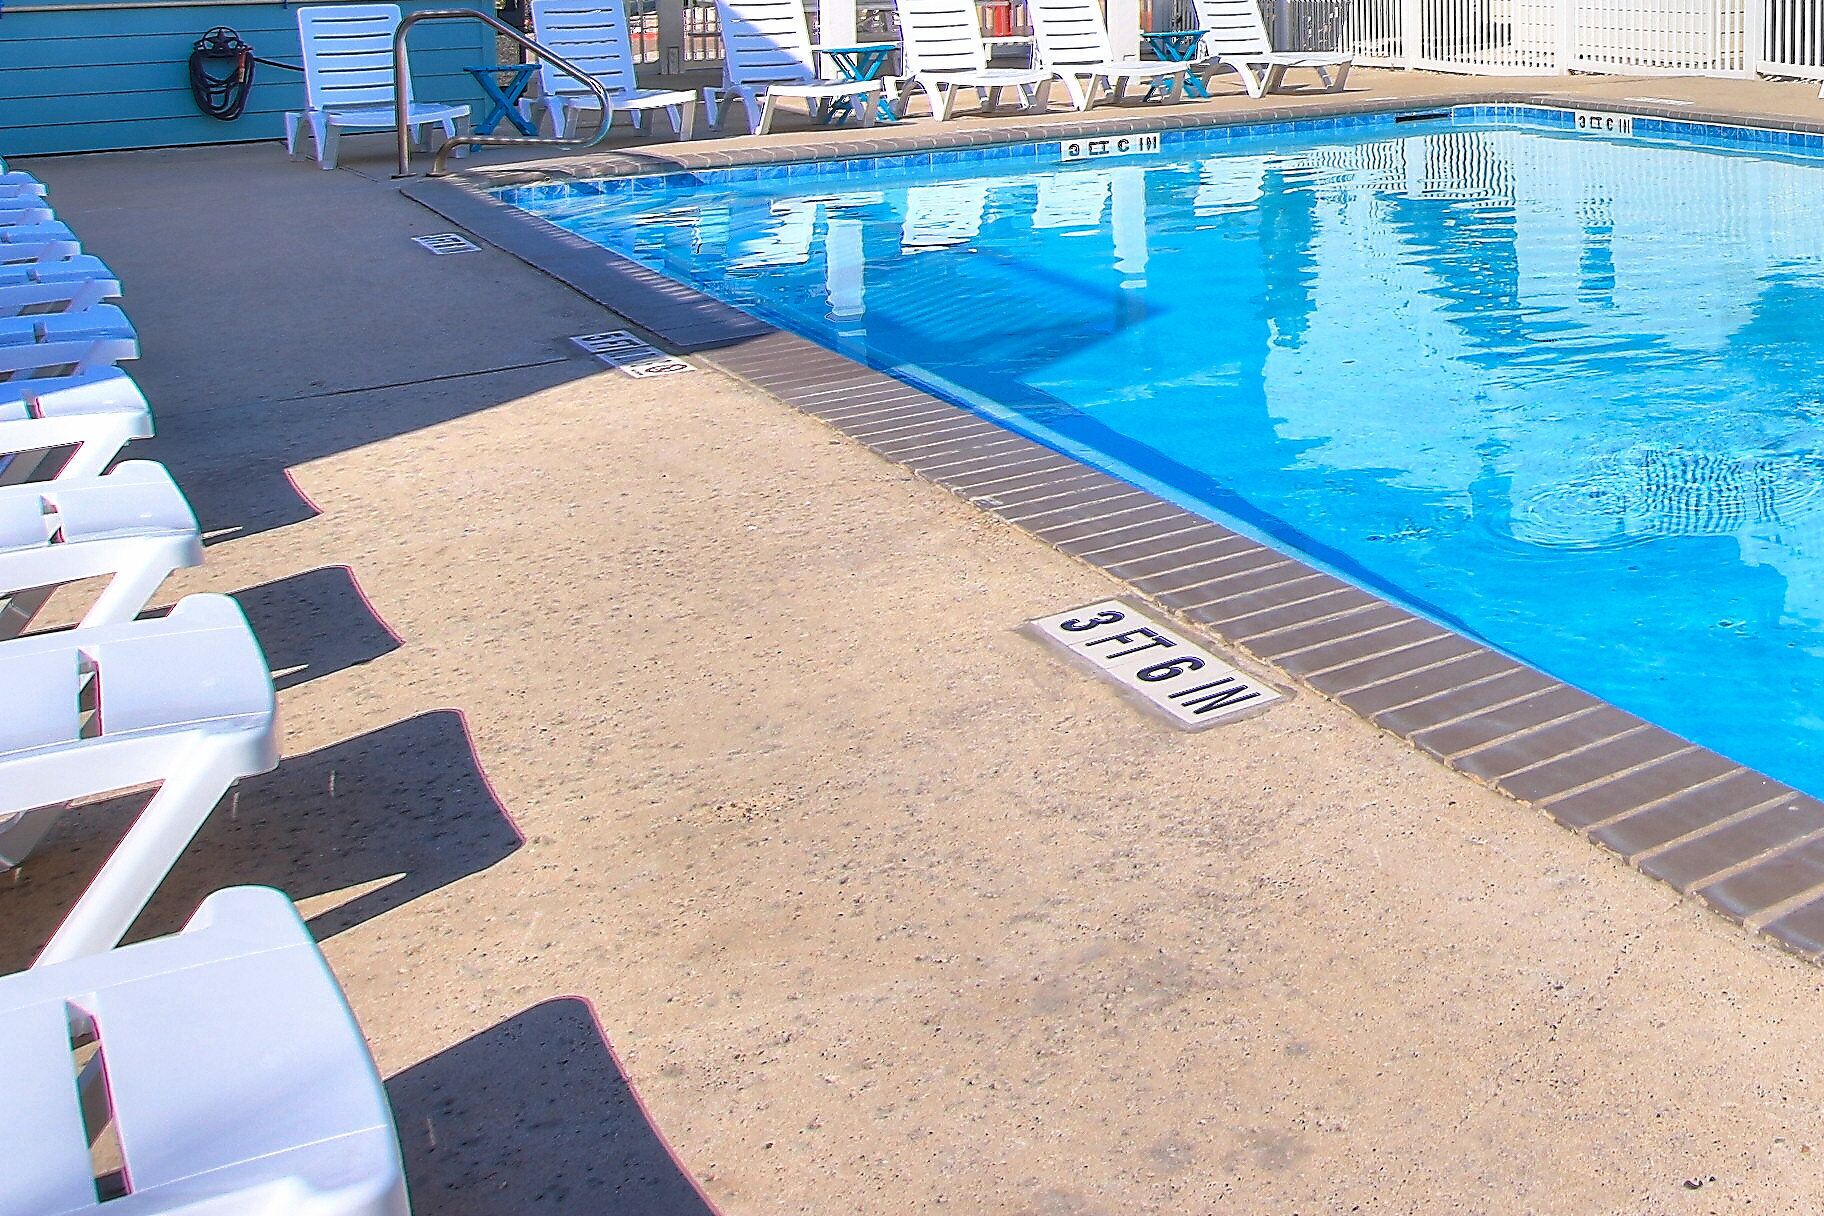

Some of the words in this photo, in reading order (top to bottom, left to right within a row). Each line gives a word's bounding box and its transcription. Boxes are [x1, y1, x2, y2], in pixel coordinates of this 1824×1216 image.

[1060, 610, 1126, 632] 3
[1085, 626, 1178, 659] FT
[1136, 655, 1206, 682] 6
[1168, 676, 1262, 715] IN
